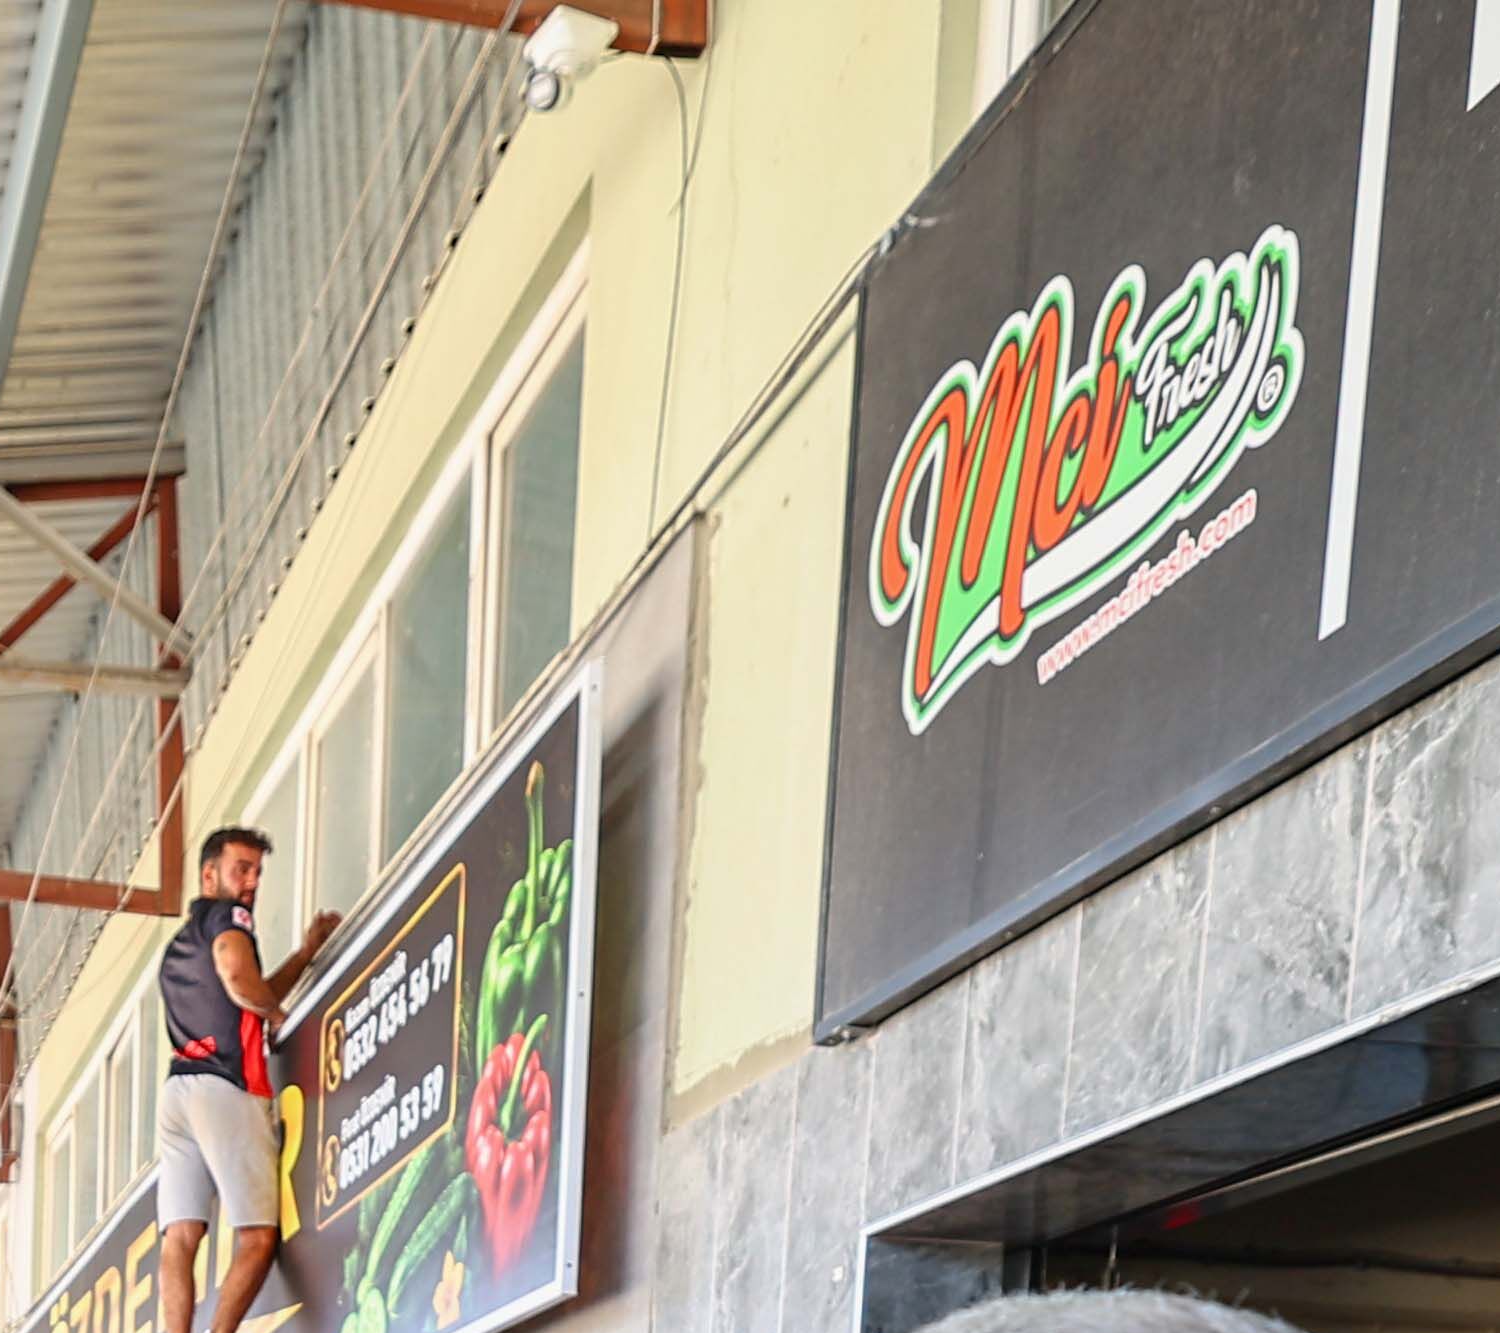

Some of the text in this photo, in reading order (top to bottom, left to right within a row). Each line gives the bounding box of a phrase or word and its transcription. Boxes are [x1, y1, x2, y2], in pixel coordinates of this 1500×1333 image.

[881, 294, 1246, 697] Mci Fresh
[1035, 489, 1257, 686] www.mcifresh.com
[399, 1085, 420, 1140] 53
